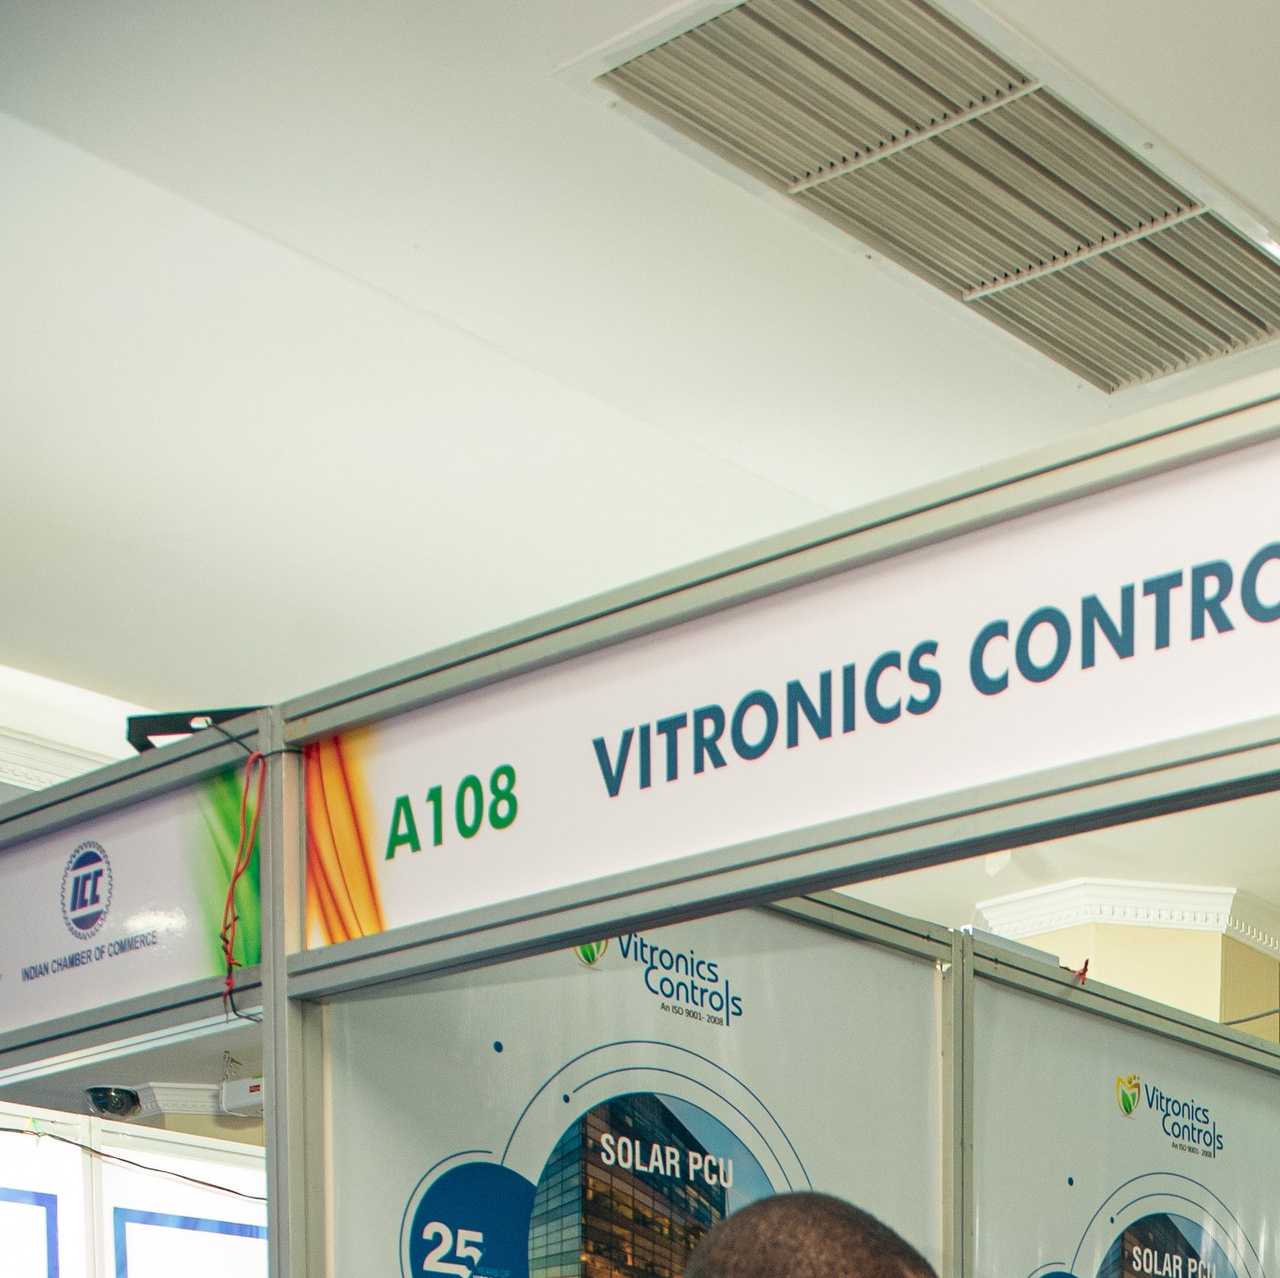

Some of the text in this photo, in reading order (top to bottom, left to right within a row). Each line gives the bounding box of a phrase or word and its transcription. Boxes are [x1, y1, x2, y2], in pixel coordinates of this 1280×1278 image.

[384, 763, 520, 861] A108
[591, 639, 943, 799] VITRONICS
[69, 868, 103, 912] ICC
[21, 930, 158, 982] INDIAN CHAMBER OF COMMERCE
[618, 933, 719, 983] Vitronics
[644, 966, 743, 1027] Controls
[660, 1002, 671, 1012] An
[671, 1005, 684, 1016] ISO
[706, 1014, 724, 1026] 2008
[1144, 1083, 1210, 1125] Vitronics
[600, 1132, 734, 1189] SOLAR PCU
[1162, 1113, 1223, 1158] Controls
